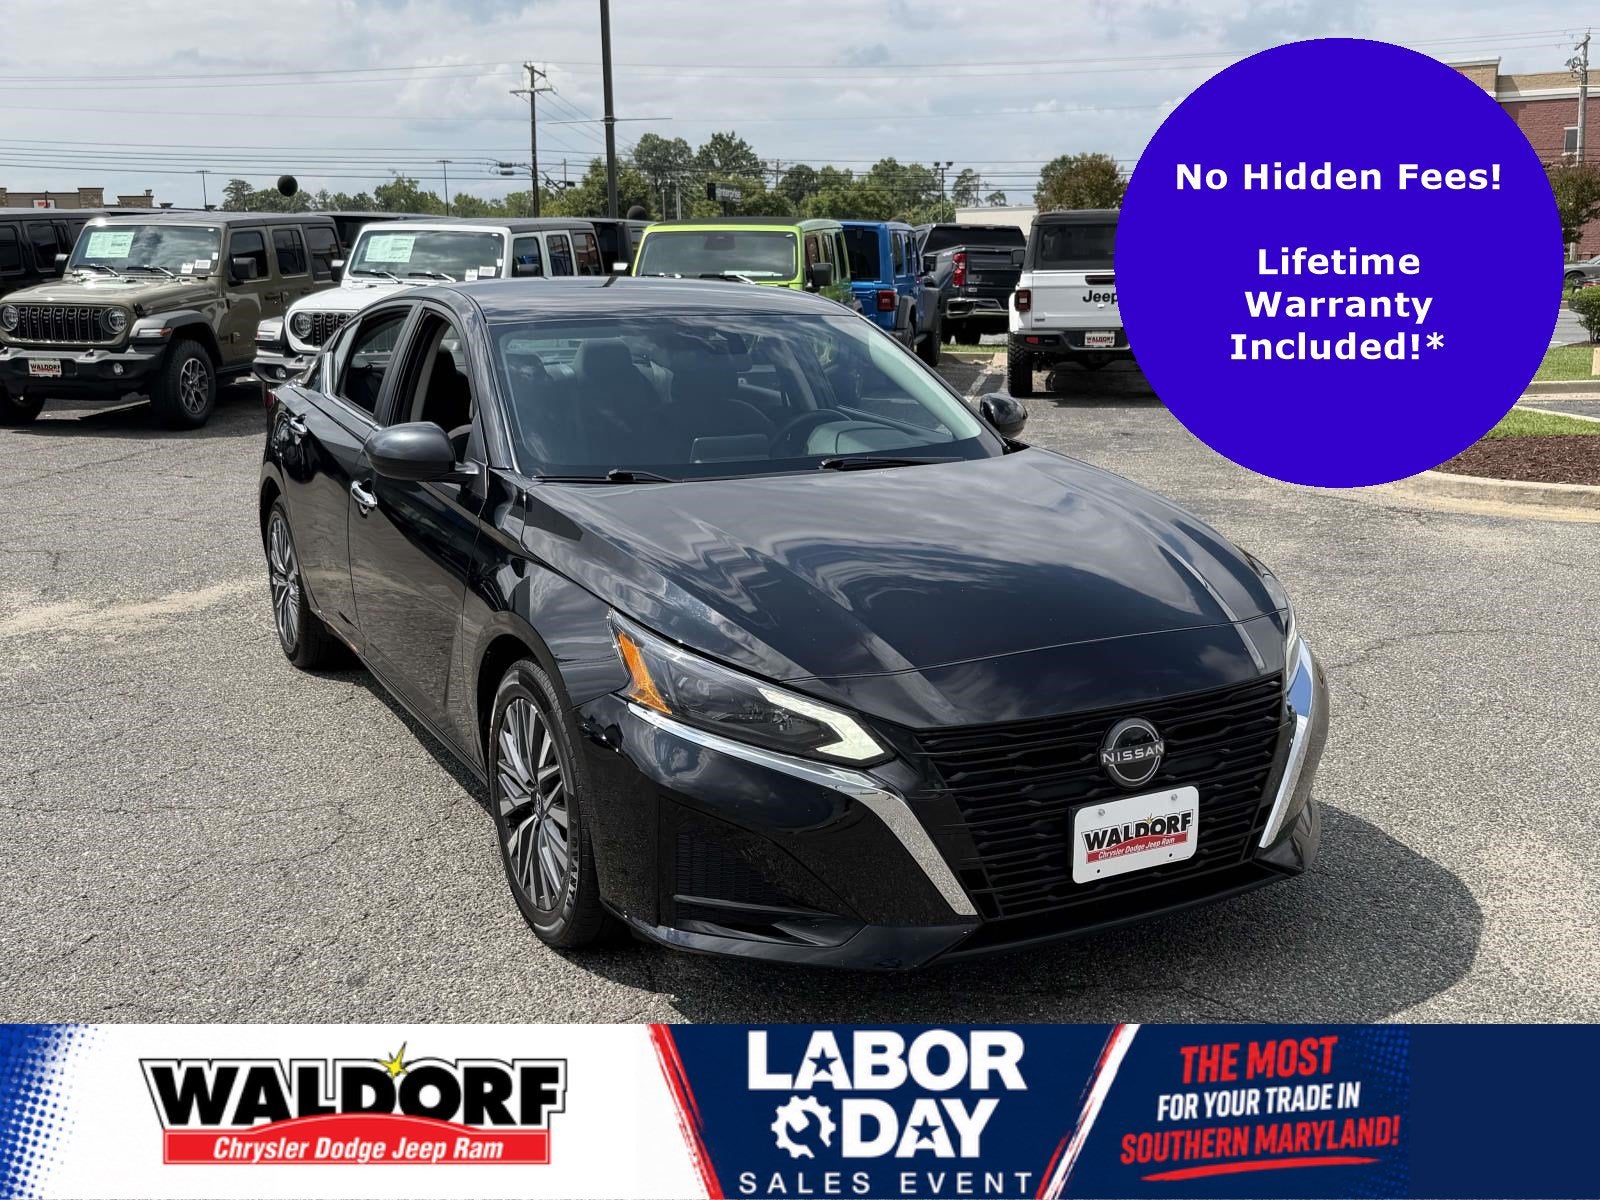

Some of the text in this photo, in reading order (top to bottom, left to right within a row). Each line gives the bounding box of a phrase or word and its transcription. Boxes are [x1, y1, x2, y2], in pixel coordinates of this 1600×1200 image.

[1102, 742, 1165, 764] NISSAN
[1083, 811, 1192, 852] WALDORF
[1098, 837, 1176, 859] Chrysler Dodge Jeep Ram
